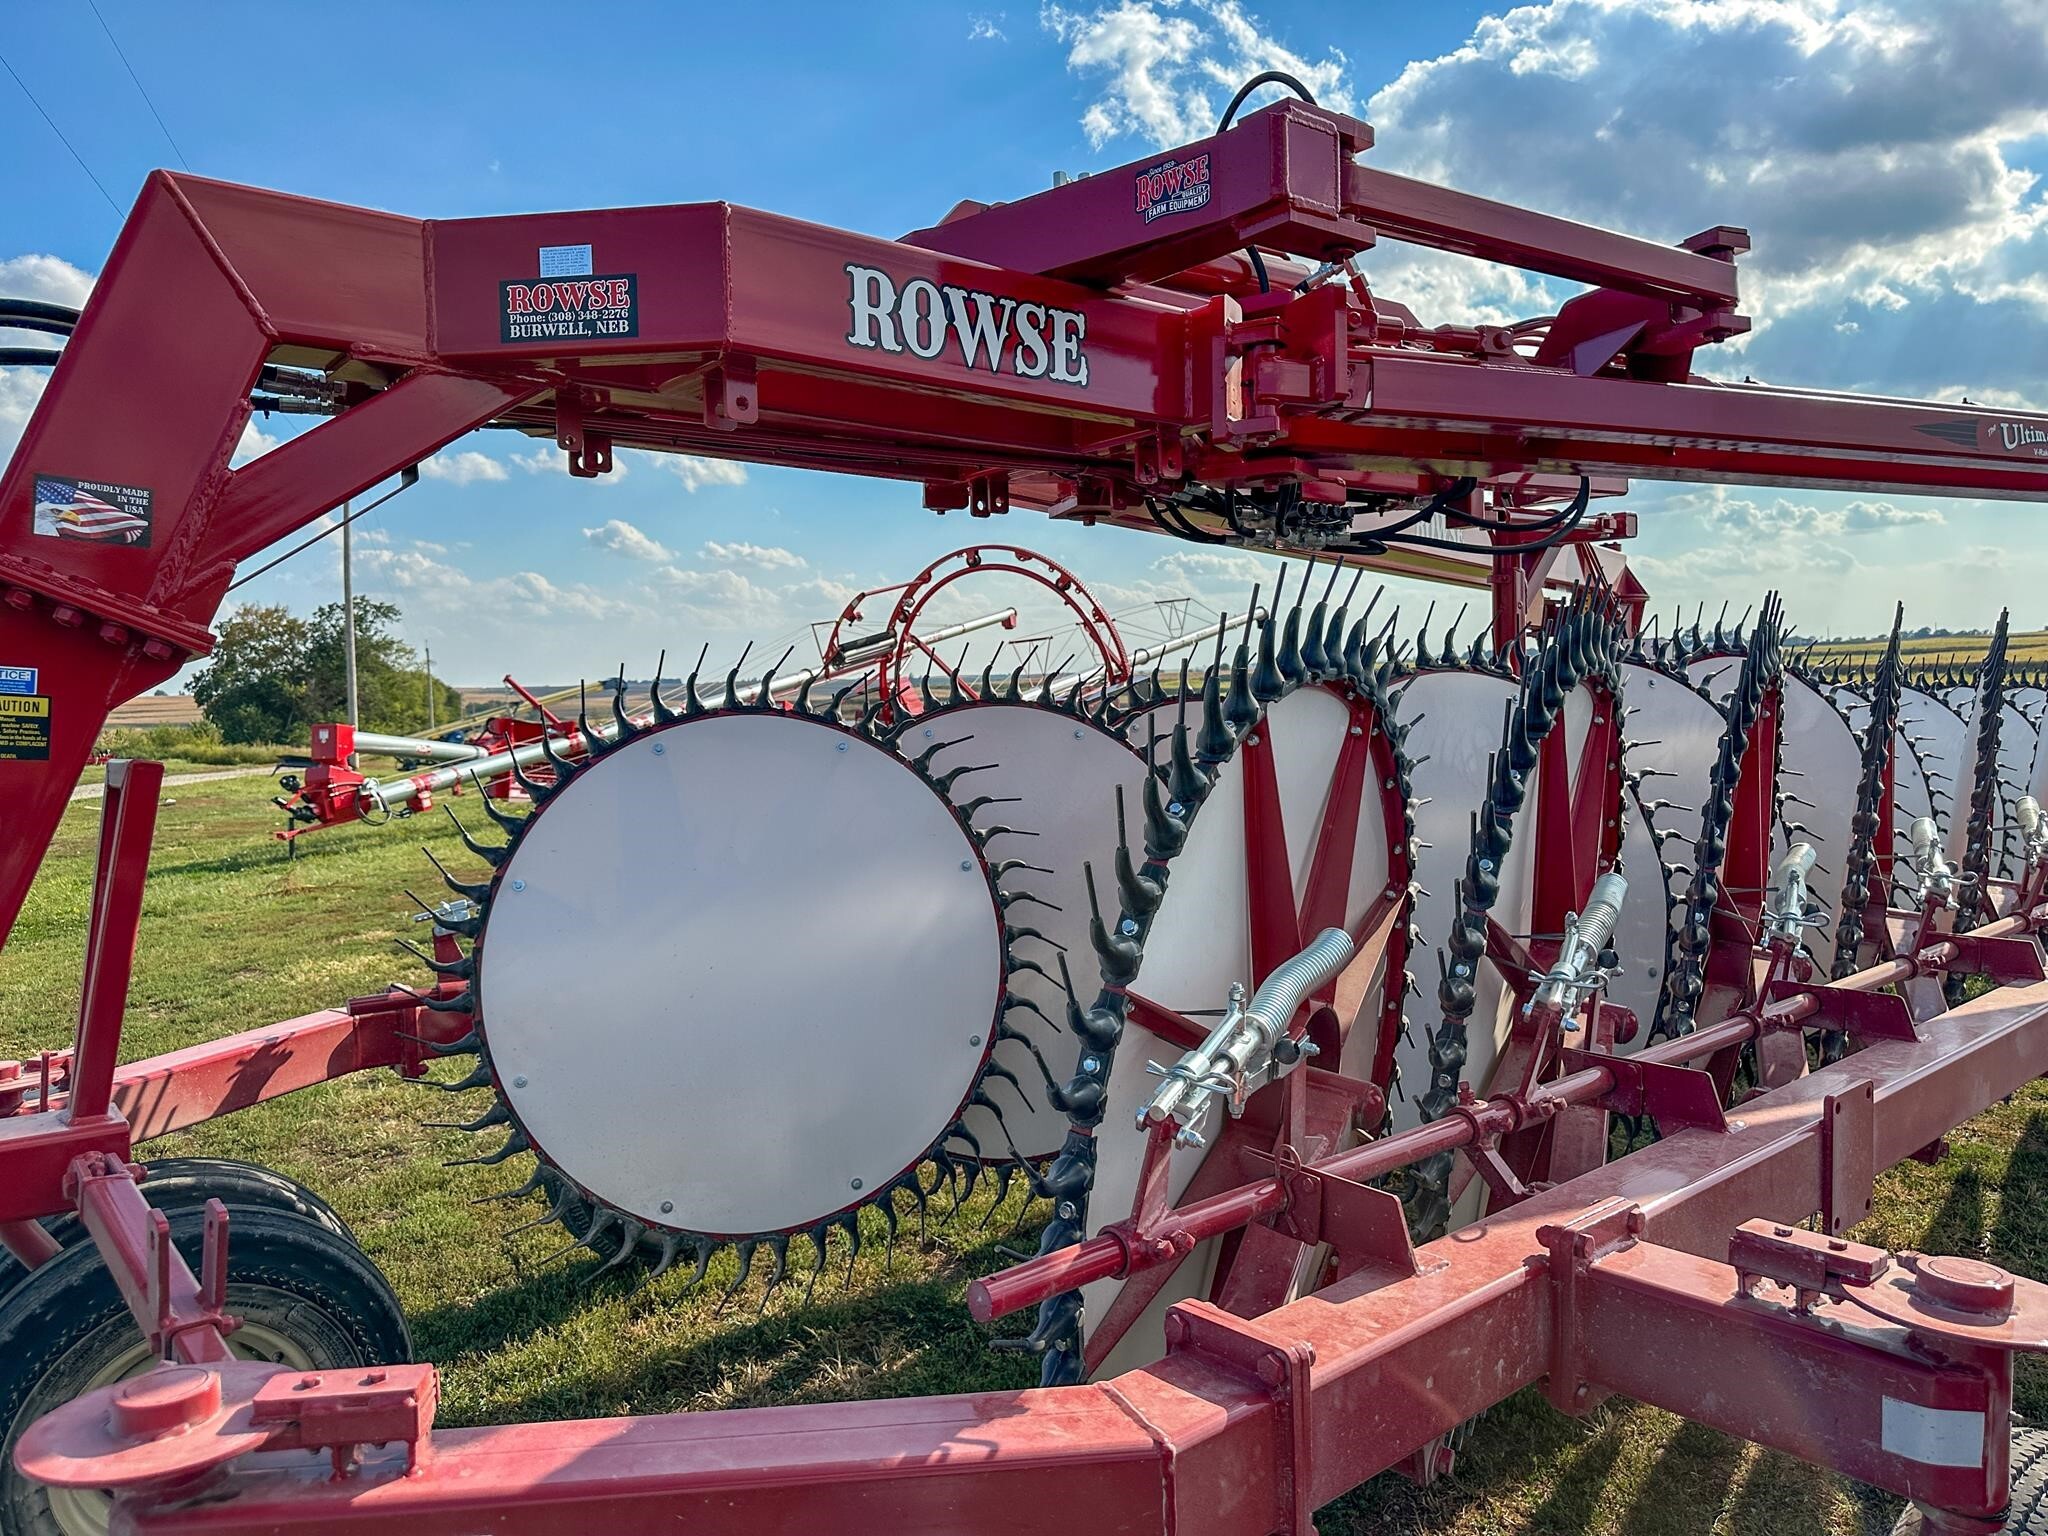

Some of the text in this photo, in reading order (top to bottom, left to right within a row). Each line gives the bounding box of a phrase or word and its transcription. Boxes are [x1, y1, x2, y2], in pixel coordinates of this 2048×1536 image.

[1136, 154, 1209, 212] ROWSE
[1181, 185, 1207, 198] QUALITY
[1148, 192, 1207, 218] FARM EQUIPMENT
[507, 279, 630, 313] ROWSE
[509, 309, 629, 323] Phone: (308) 348-2276
[510, 319, 630, 337] BURWELL, NEB
[845, 264, 1089, 387] ROWSE
[2000, 422, 2048, 450] Ultim
[77, 481, 150, 498] PROUDLY MADE
[124, 505, 144, 514] USA
[129, 497, 149, 506] THE
[0, 700, 40, 713] UTION
